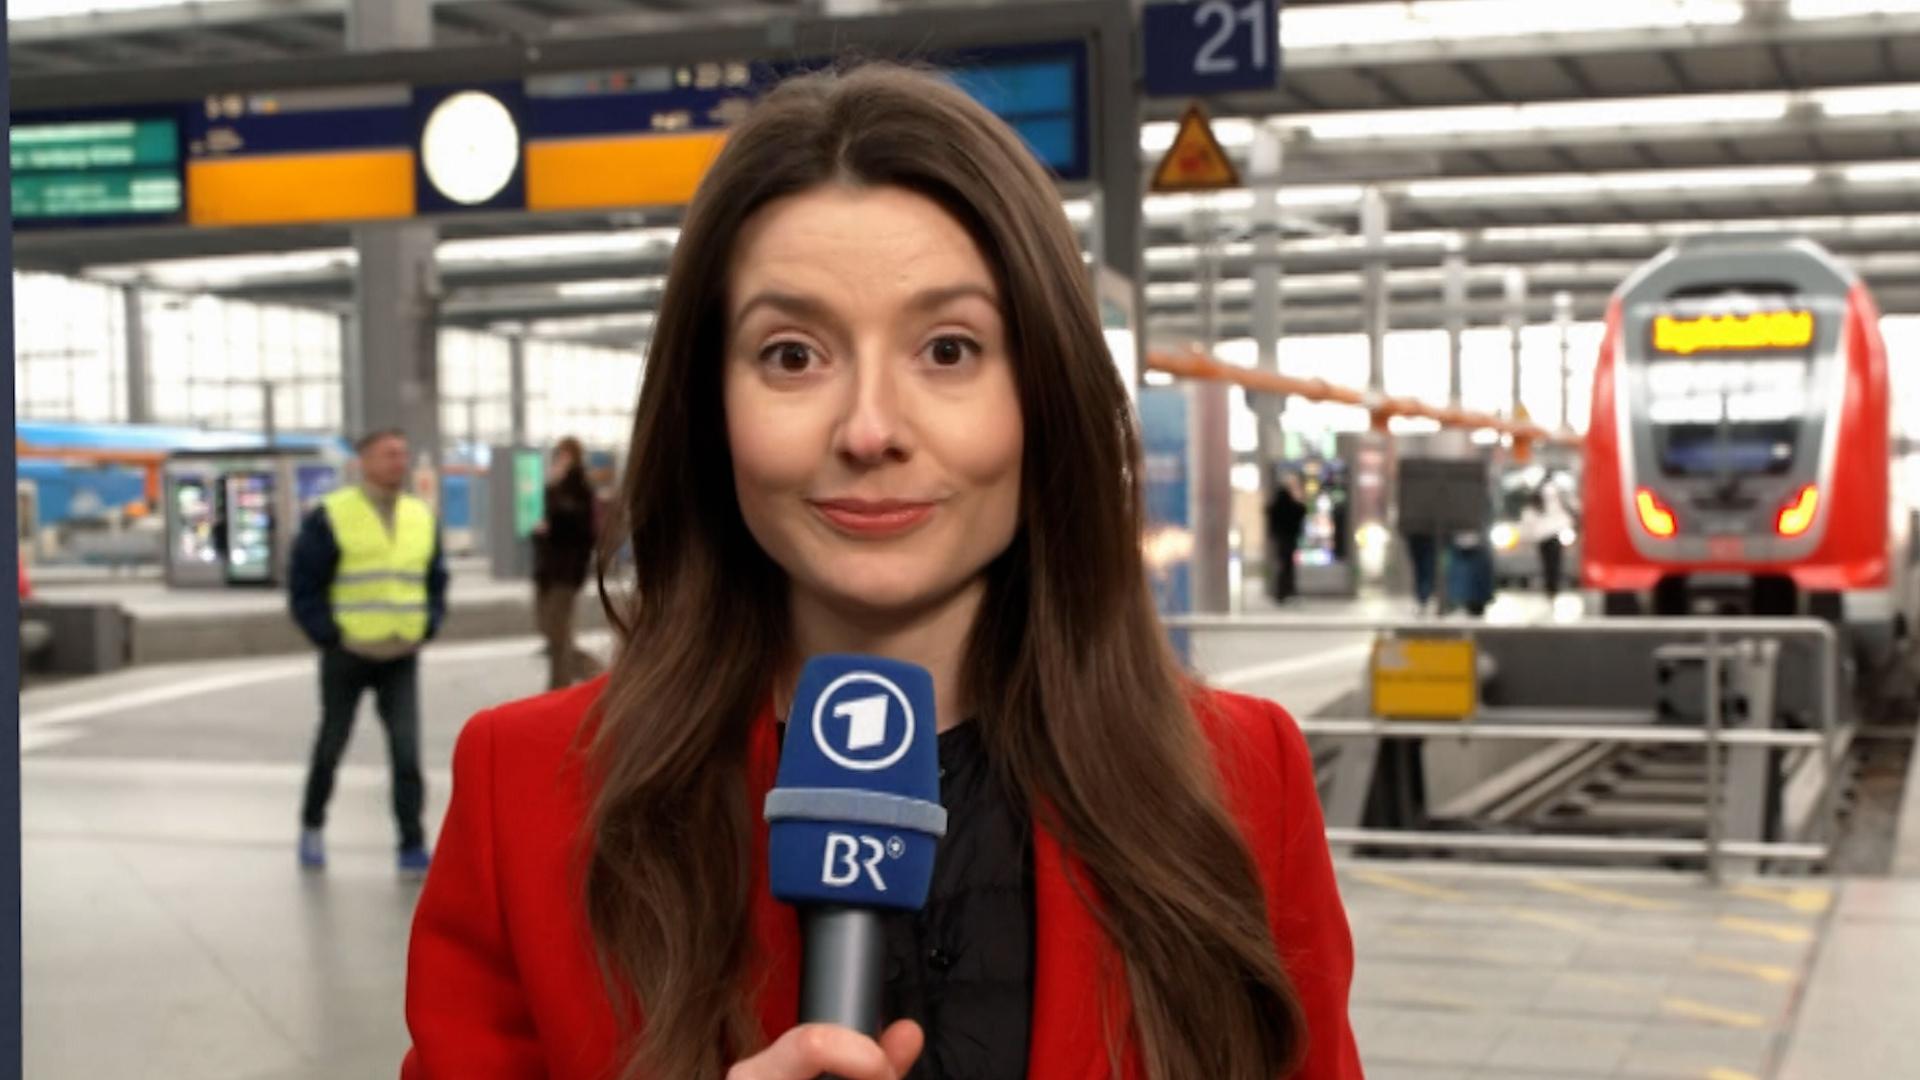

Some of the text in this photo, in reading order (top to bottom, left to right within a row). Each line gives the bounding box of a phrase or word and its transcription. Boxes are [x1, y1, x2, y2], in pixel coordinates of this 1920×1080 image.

[1193, 0, 1268, 74] 21
[832, 694, 889, 750] 1
[821, 832, 887, 891] BR
